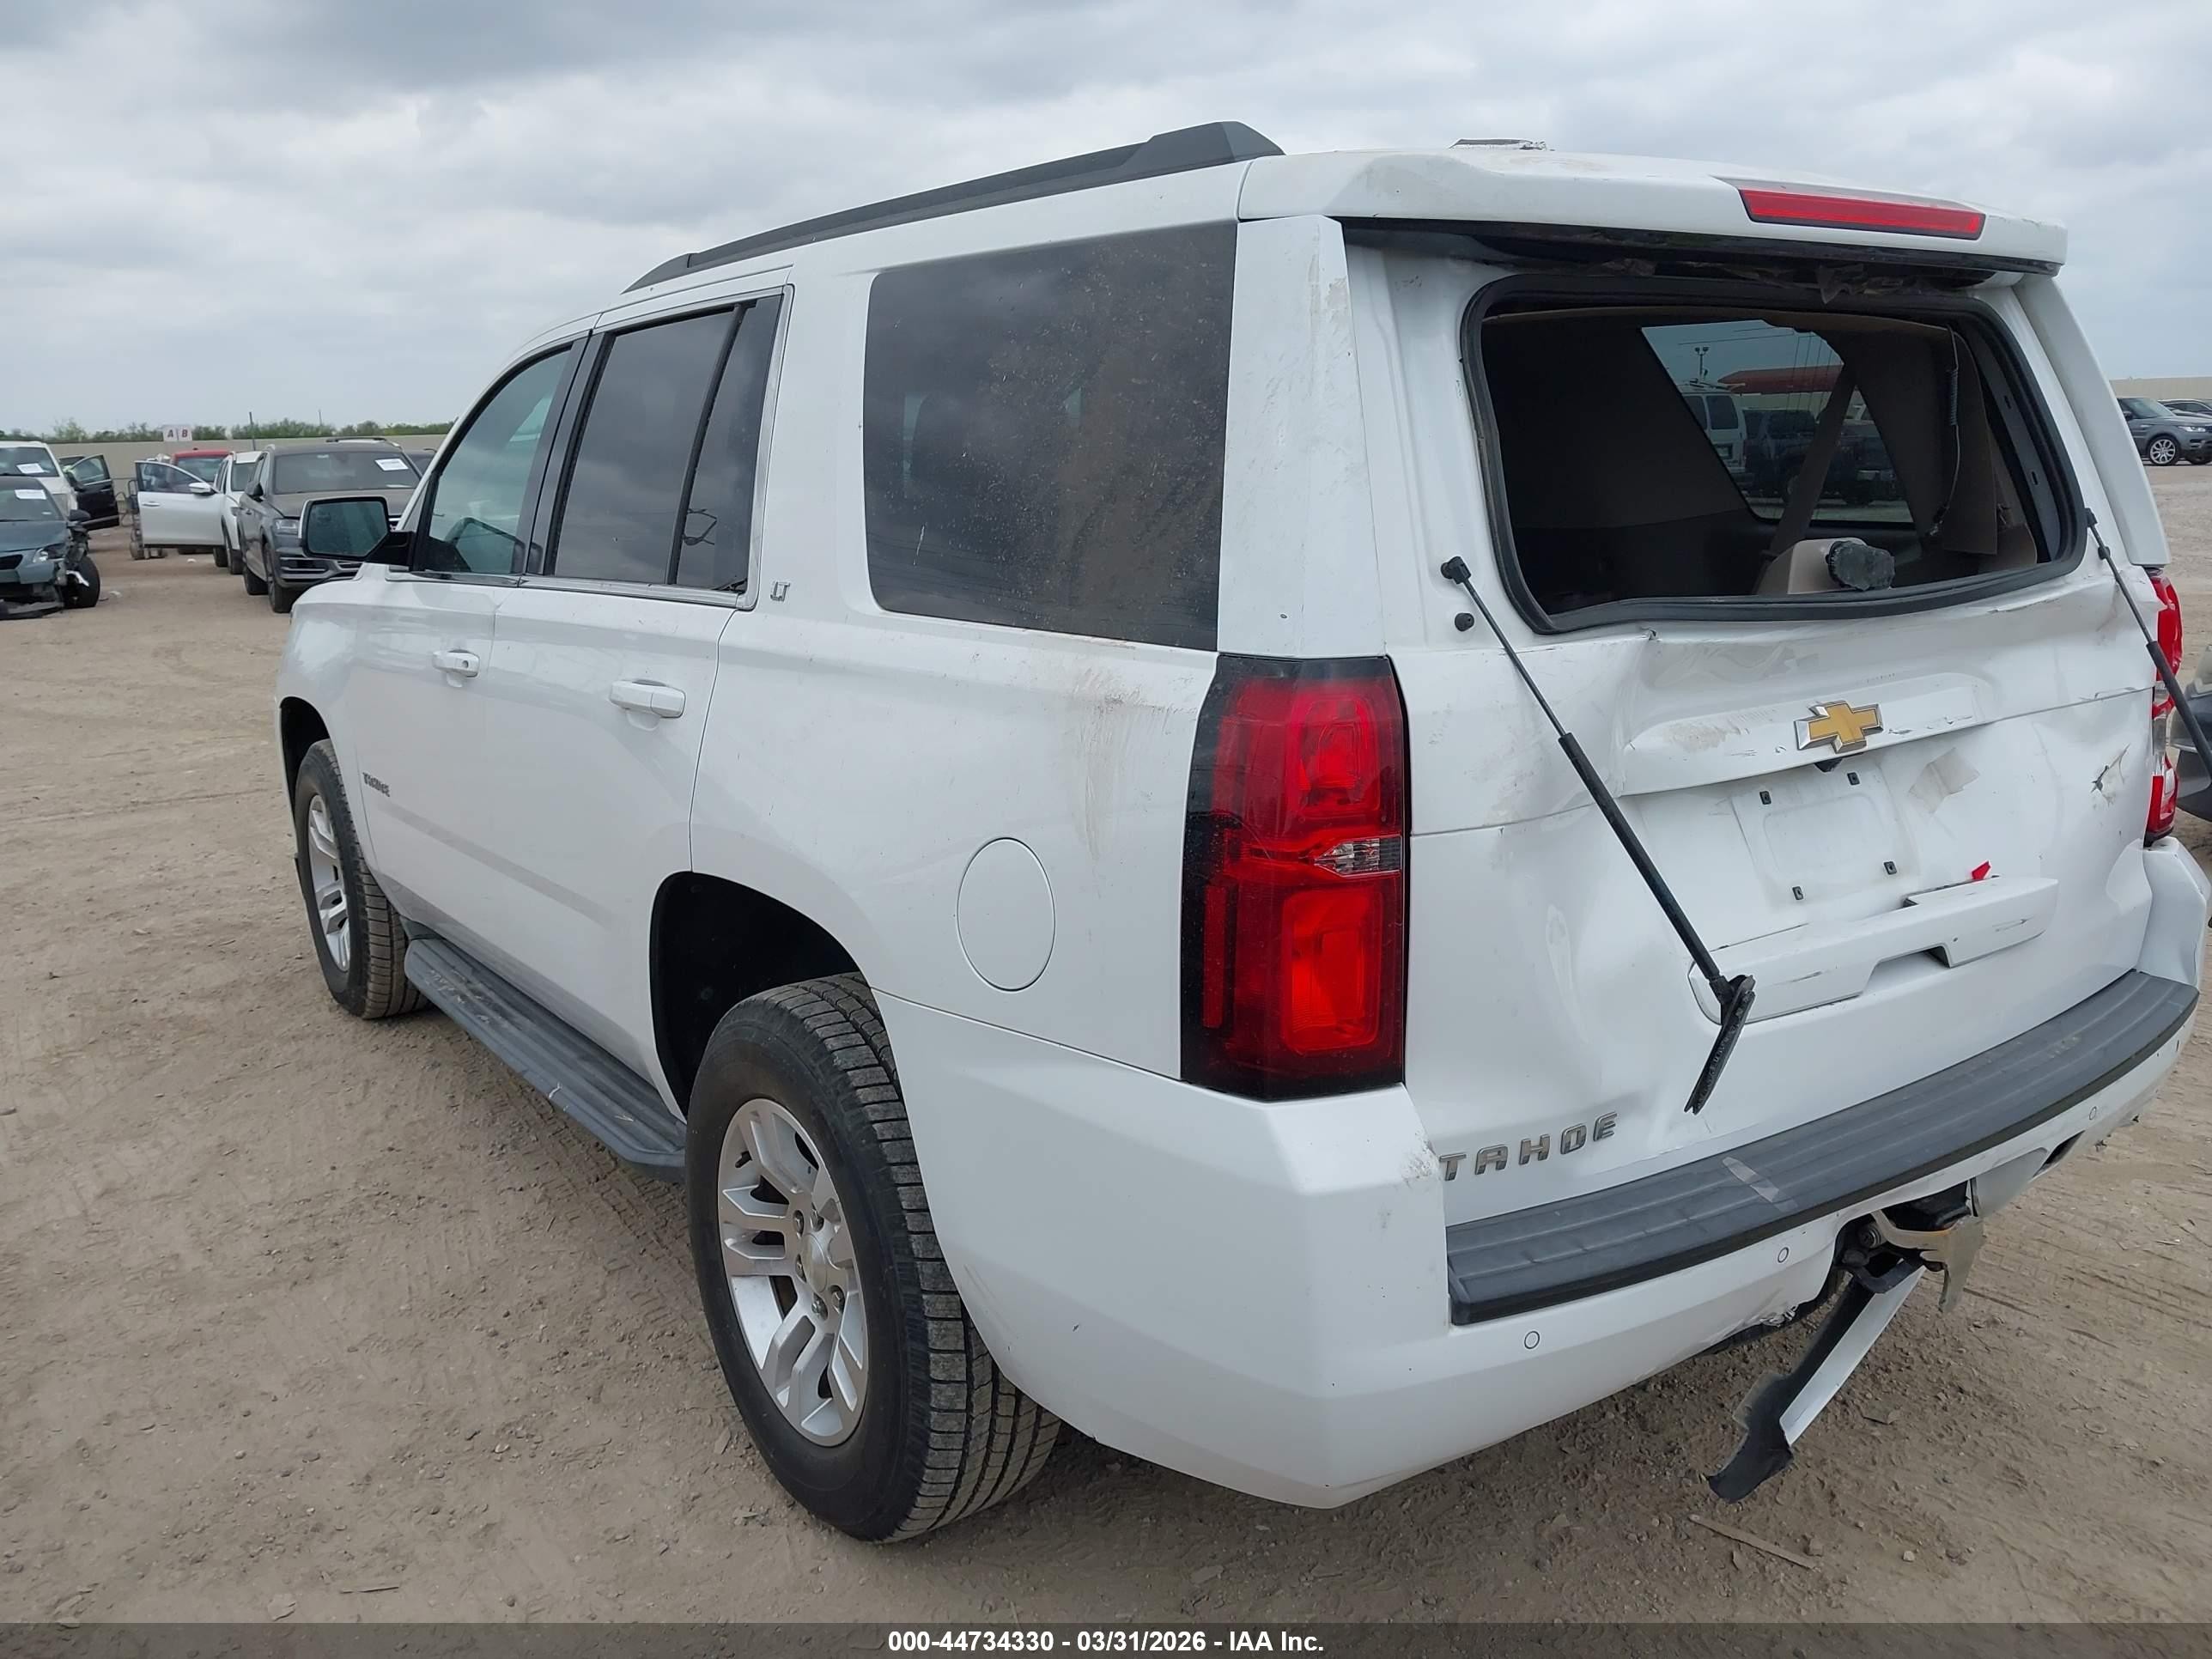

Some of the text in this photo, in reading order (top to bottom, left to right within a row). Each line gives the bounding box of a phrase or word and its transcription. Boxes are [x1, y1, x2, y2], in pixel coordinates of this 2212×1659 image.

[167, 428, 188, 438] A B
[769, 581, 791, 602] LT
[1438, 1110, 1618, 1182] TAHOE
